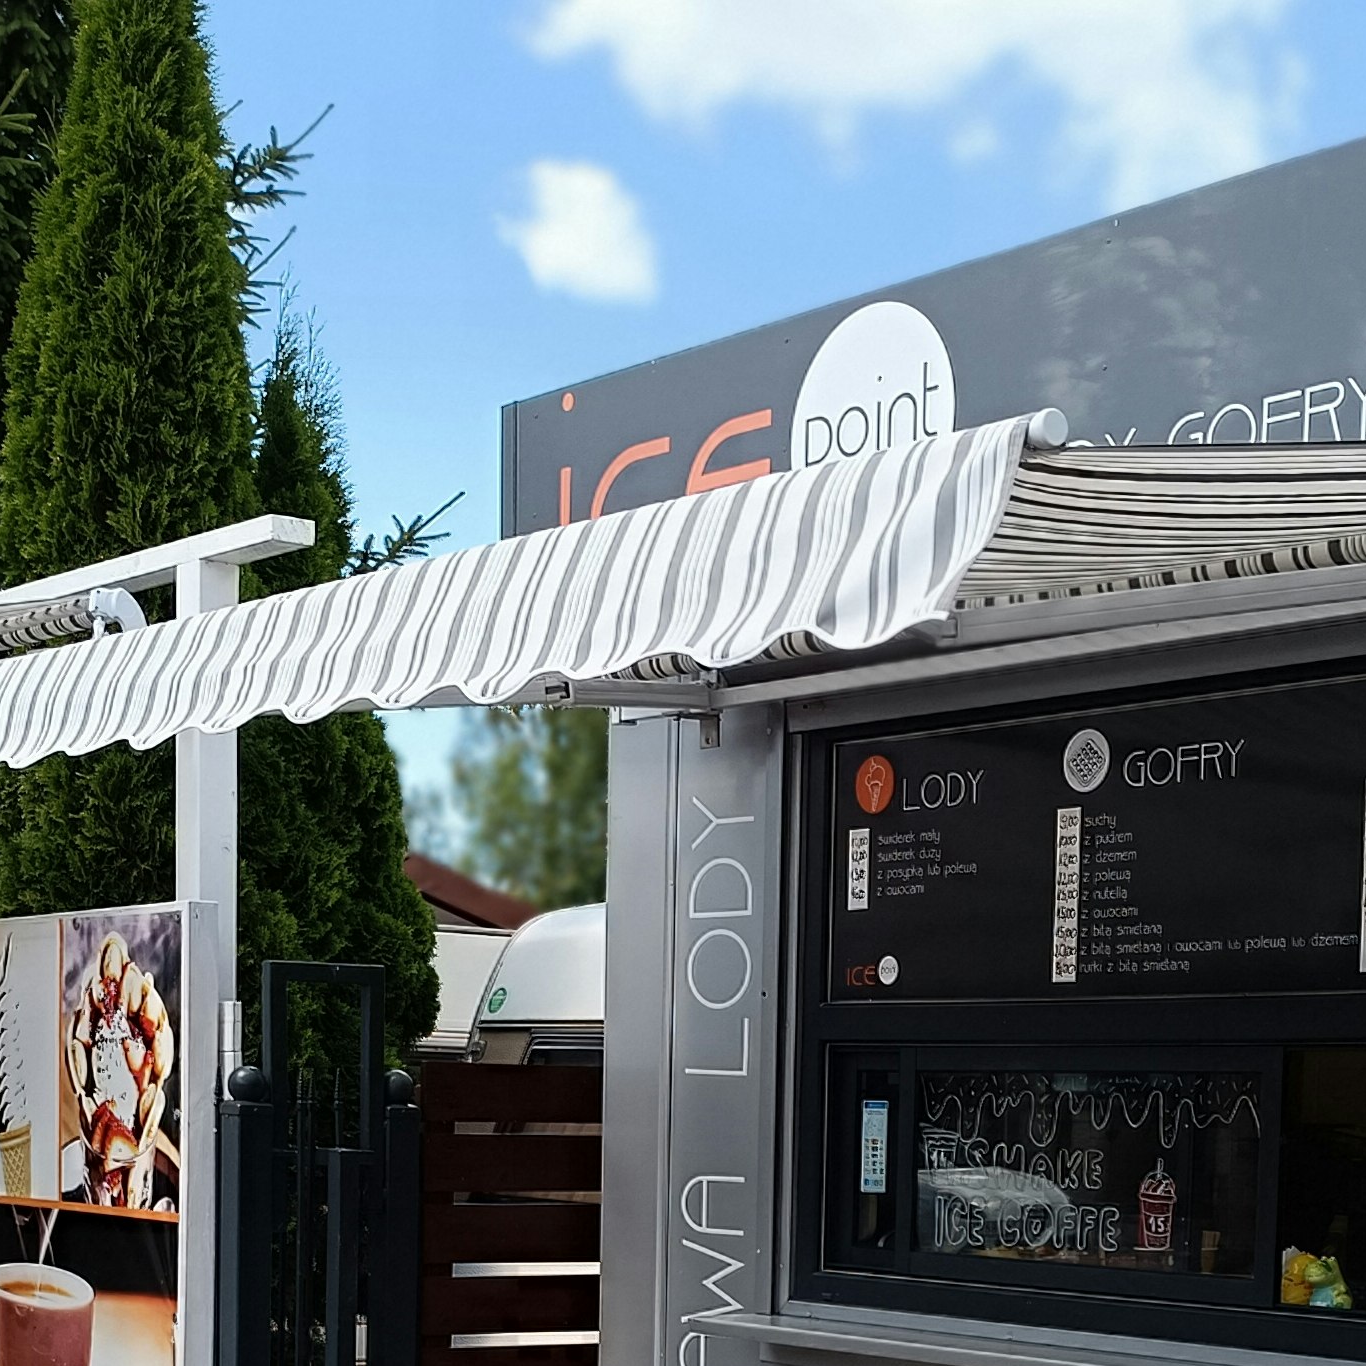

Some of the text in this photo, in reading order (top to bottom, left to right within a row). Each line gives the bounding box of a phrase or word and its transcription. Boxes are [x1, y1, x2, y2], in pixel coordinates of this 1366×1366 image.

[805, 361, 939, 468] point
[1122, 738, 1247, 787] GOFRY
[902, 769, 985, 811] LODY
[1084, 813, 1117, 830] suchy
[1095, 831, 1133, 848] pudrem
[927, 862, 941, 876] lub
[1094, 868, 1131, 886] polewą
[886, 884, 924, 896] owocami
[1093, 906, 1138, 919] owocami
[683, 795, 755, 1077] LODY
[1092, 923, 1112, 941] bitą
[1091, 941, 1112, 958] bitą
[1175, 940, 1223, 952] owocami
[1228, 939, 1242, 950] lub
[1244, 935, 1287, 953] polewą
[1292, 937, 1306, 948] lub
[1079, 959, 1103, 974] rurki
[1118, 958, 1139, 975] bitą
[935, 1194, 1120, 1251] ICE COFFE
